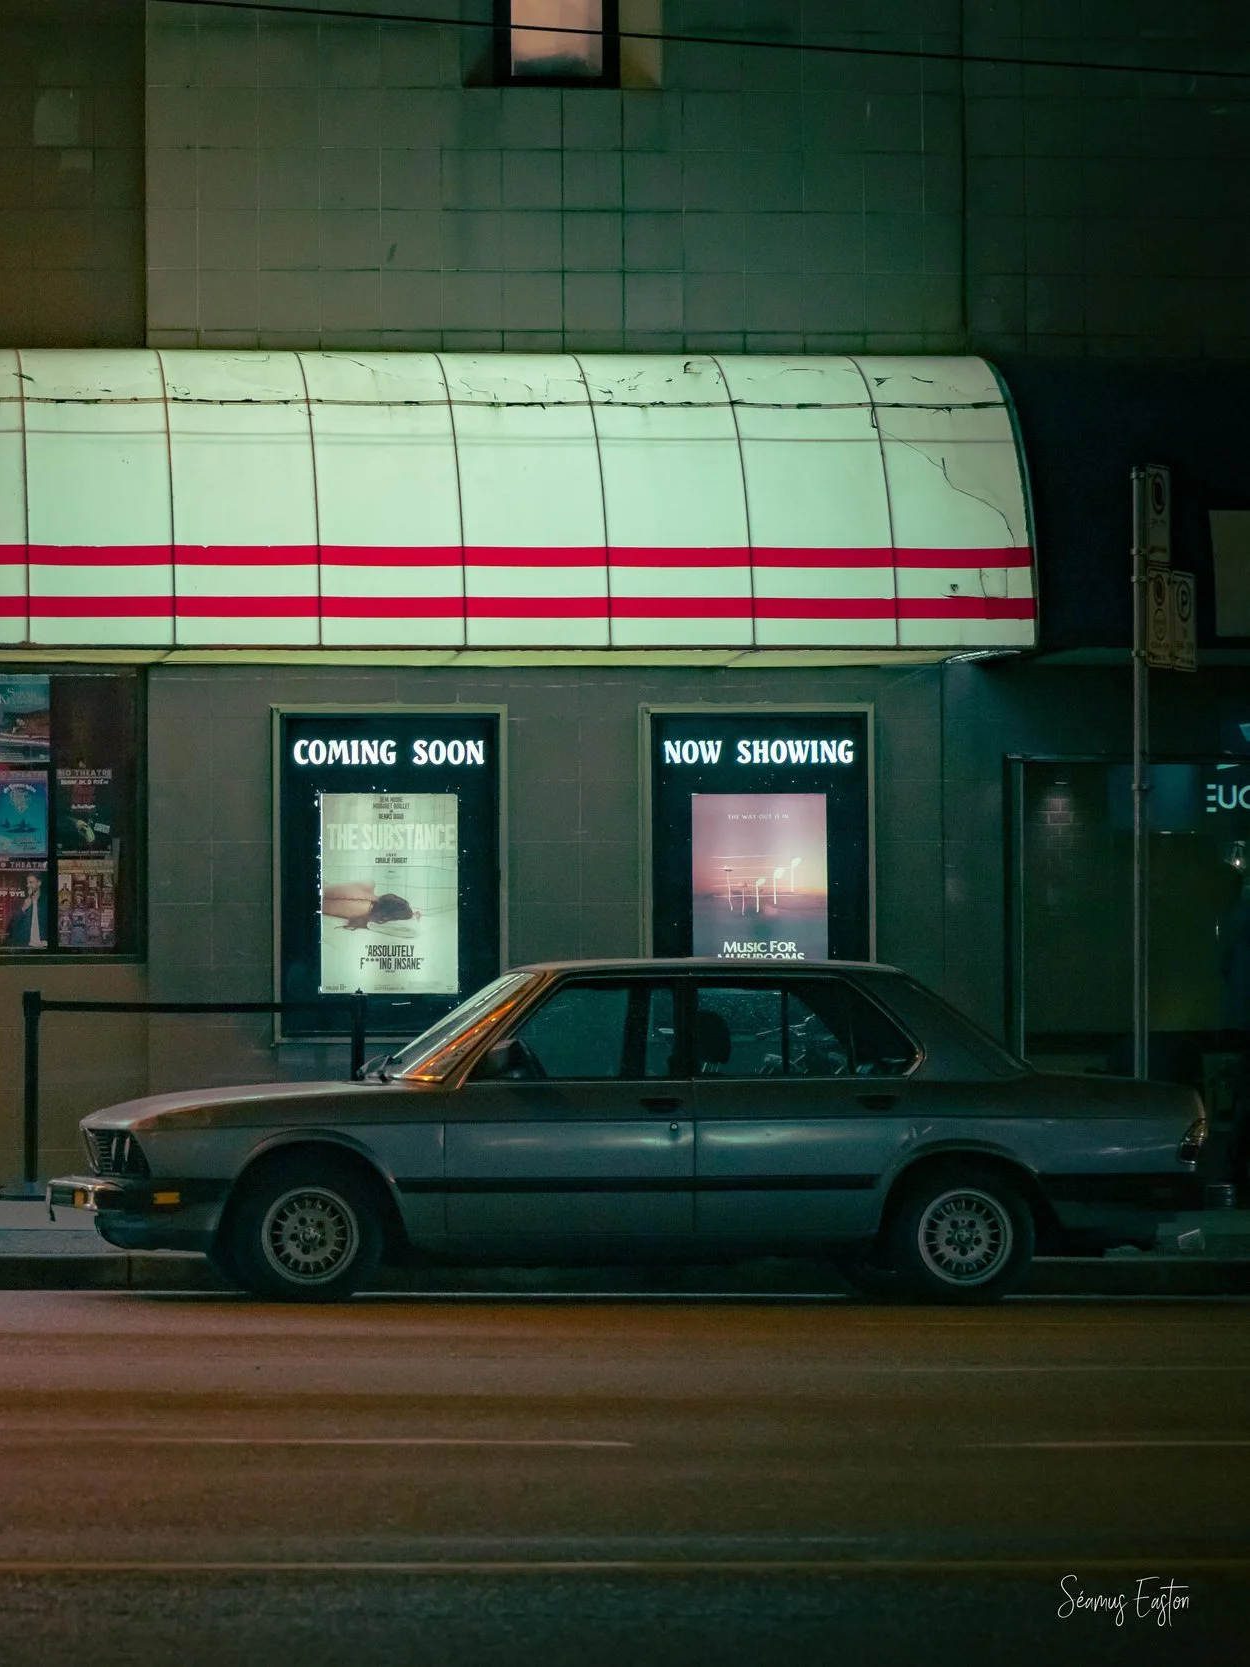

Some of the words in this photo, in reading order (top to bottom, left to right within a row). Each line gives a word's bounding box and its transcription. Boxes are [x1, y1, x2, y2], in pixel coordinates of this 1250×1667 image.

[293, 739, 397, 765] COMING
[413, 739, 485, 765] SOON
[663, 739, 723, 765] NOW
[737, 739, 855, 765] SHOWING
[326, 823, 359, 850] THE
[362, 823, 456, 850] SUBSTANCE
